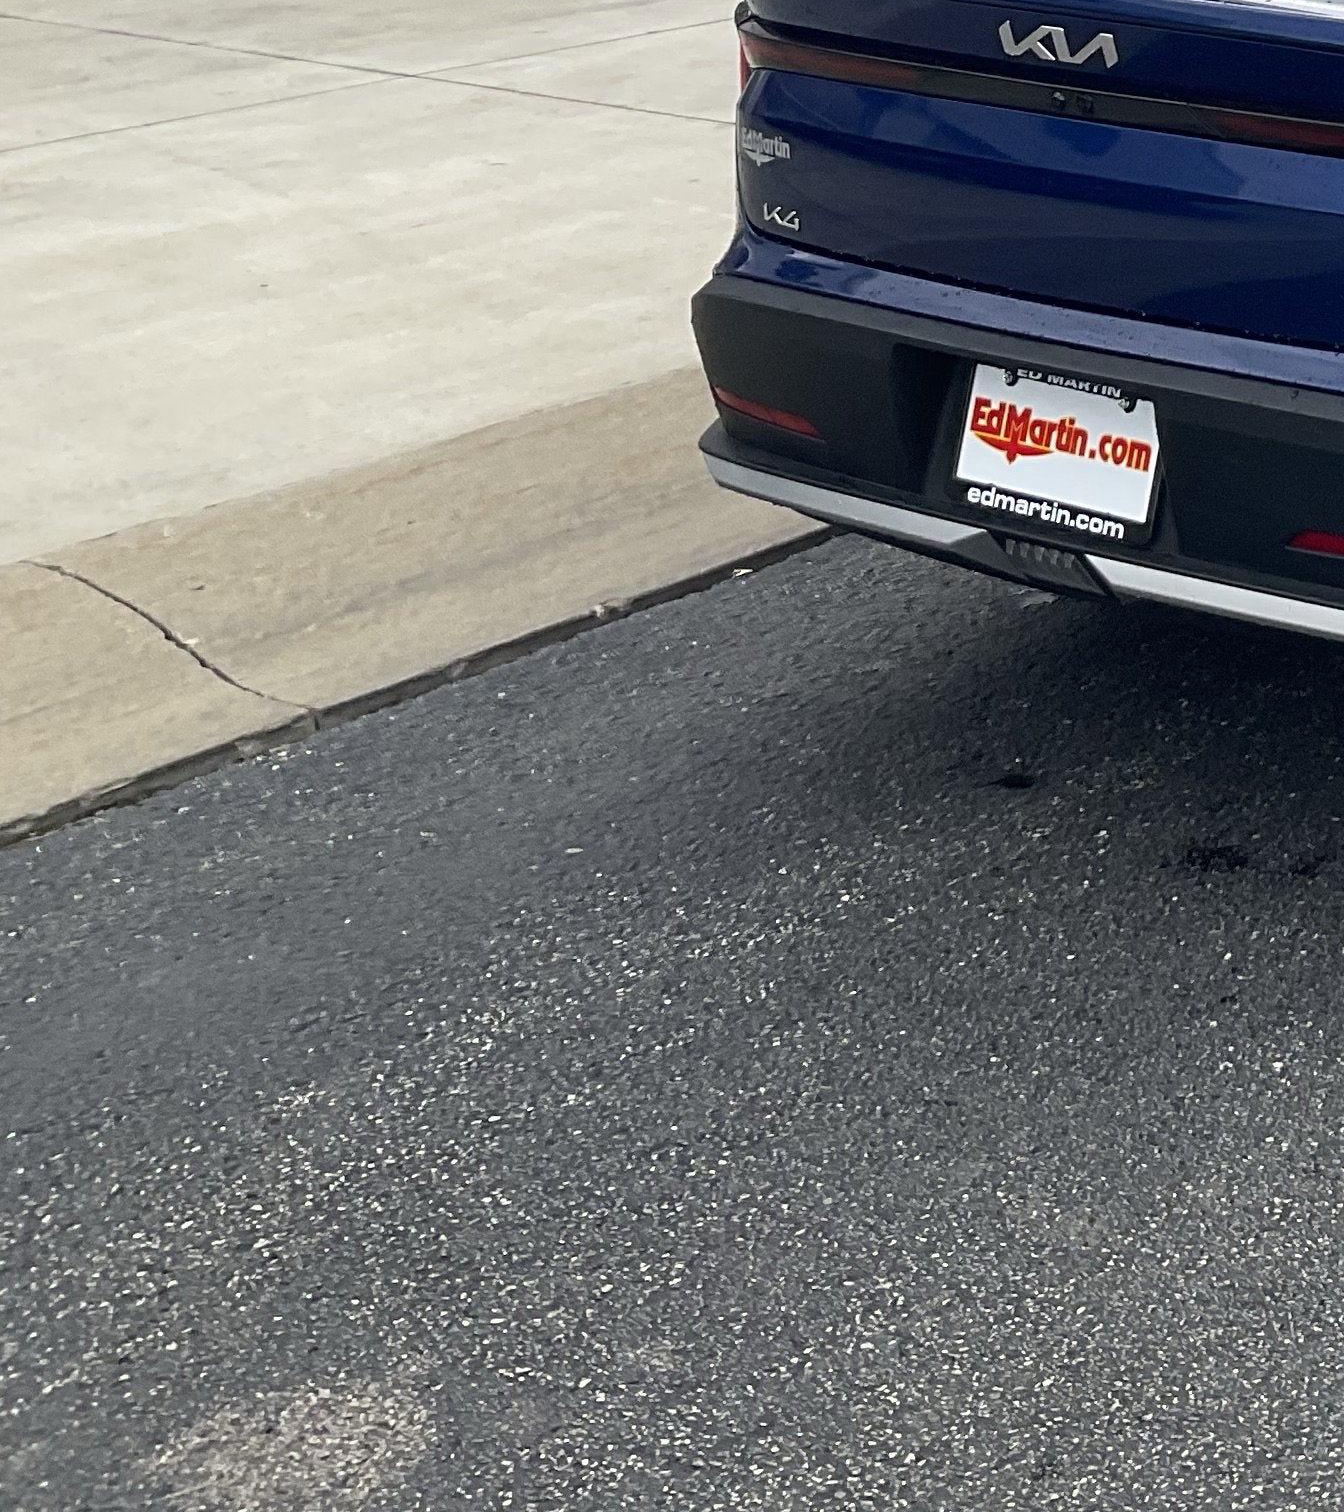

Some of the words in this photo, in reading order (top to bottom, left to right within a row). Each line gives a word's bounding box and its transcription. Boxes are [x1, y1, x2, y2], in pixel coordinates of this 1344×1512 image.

[998, 19, 1119, 69] KIA
[763, 201, 800, 232] K4
[970, 396, 1152, 473] EdMartin.com
[967, 486, 1126, 540] edmartin.com
